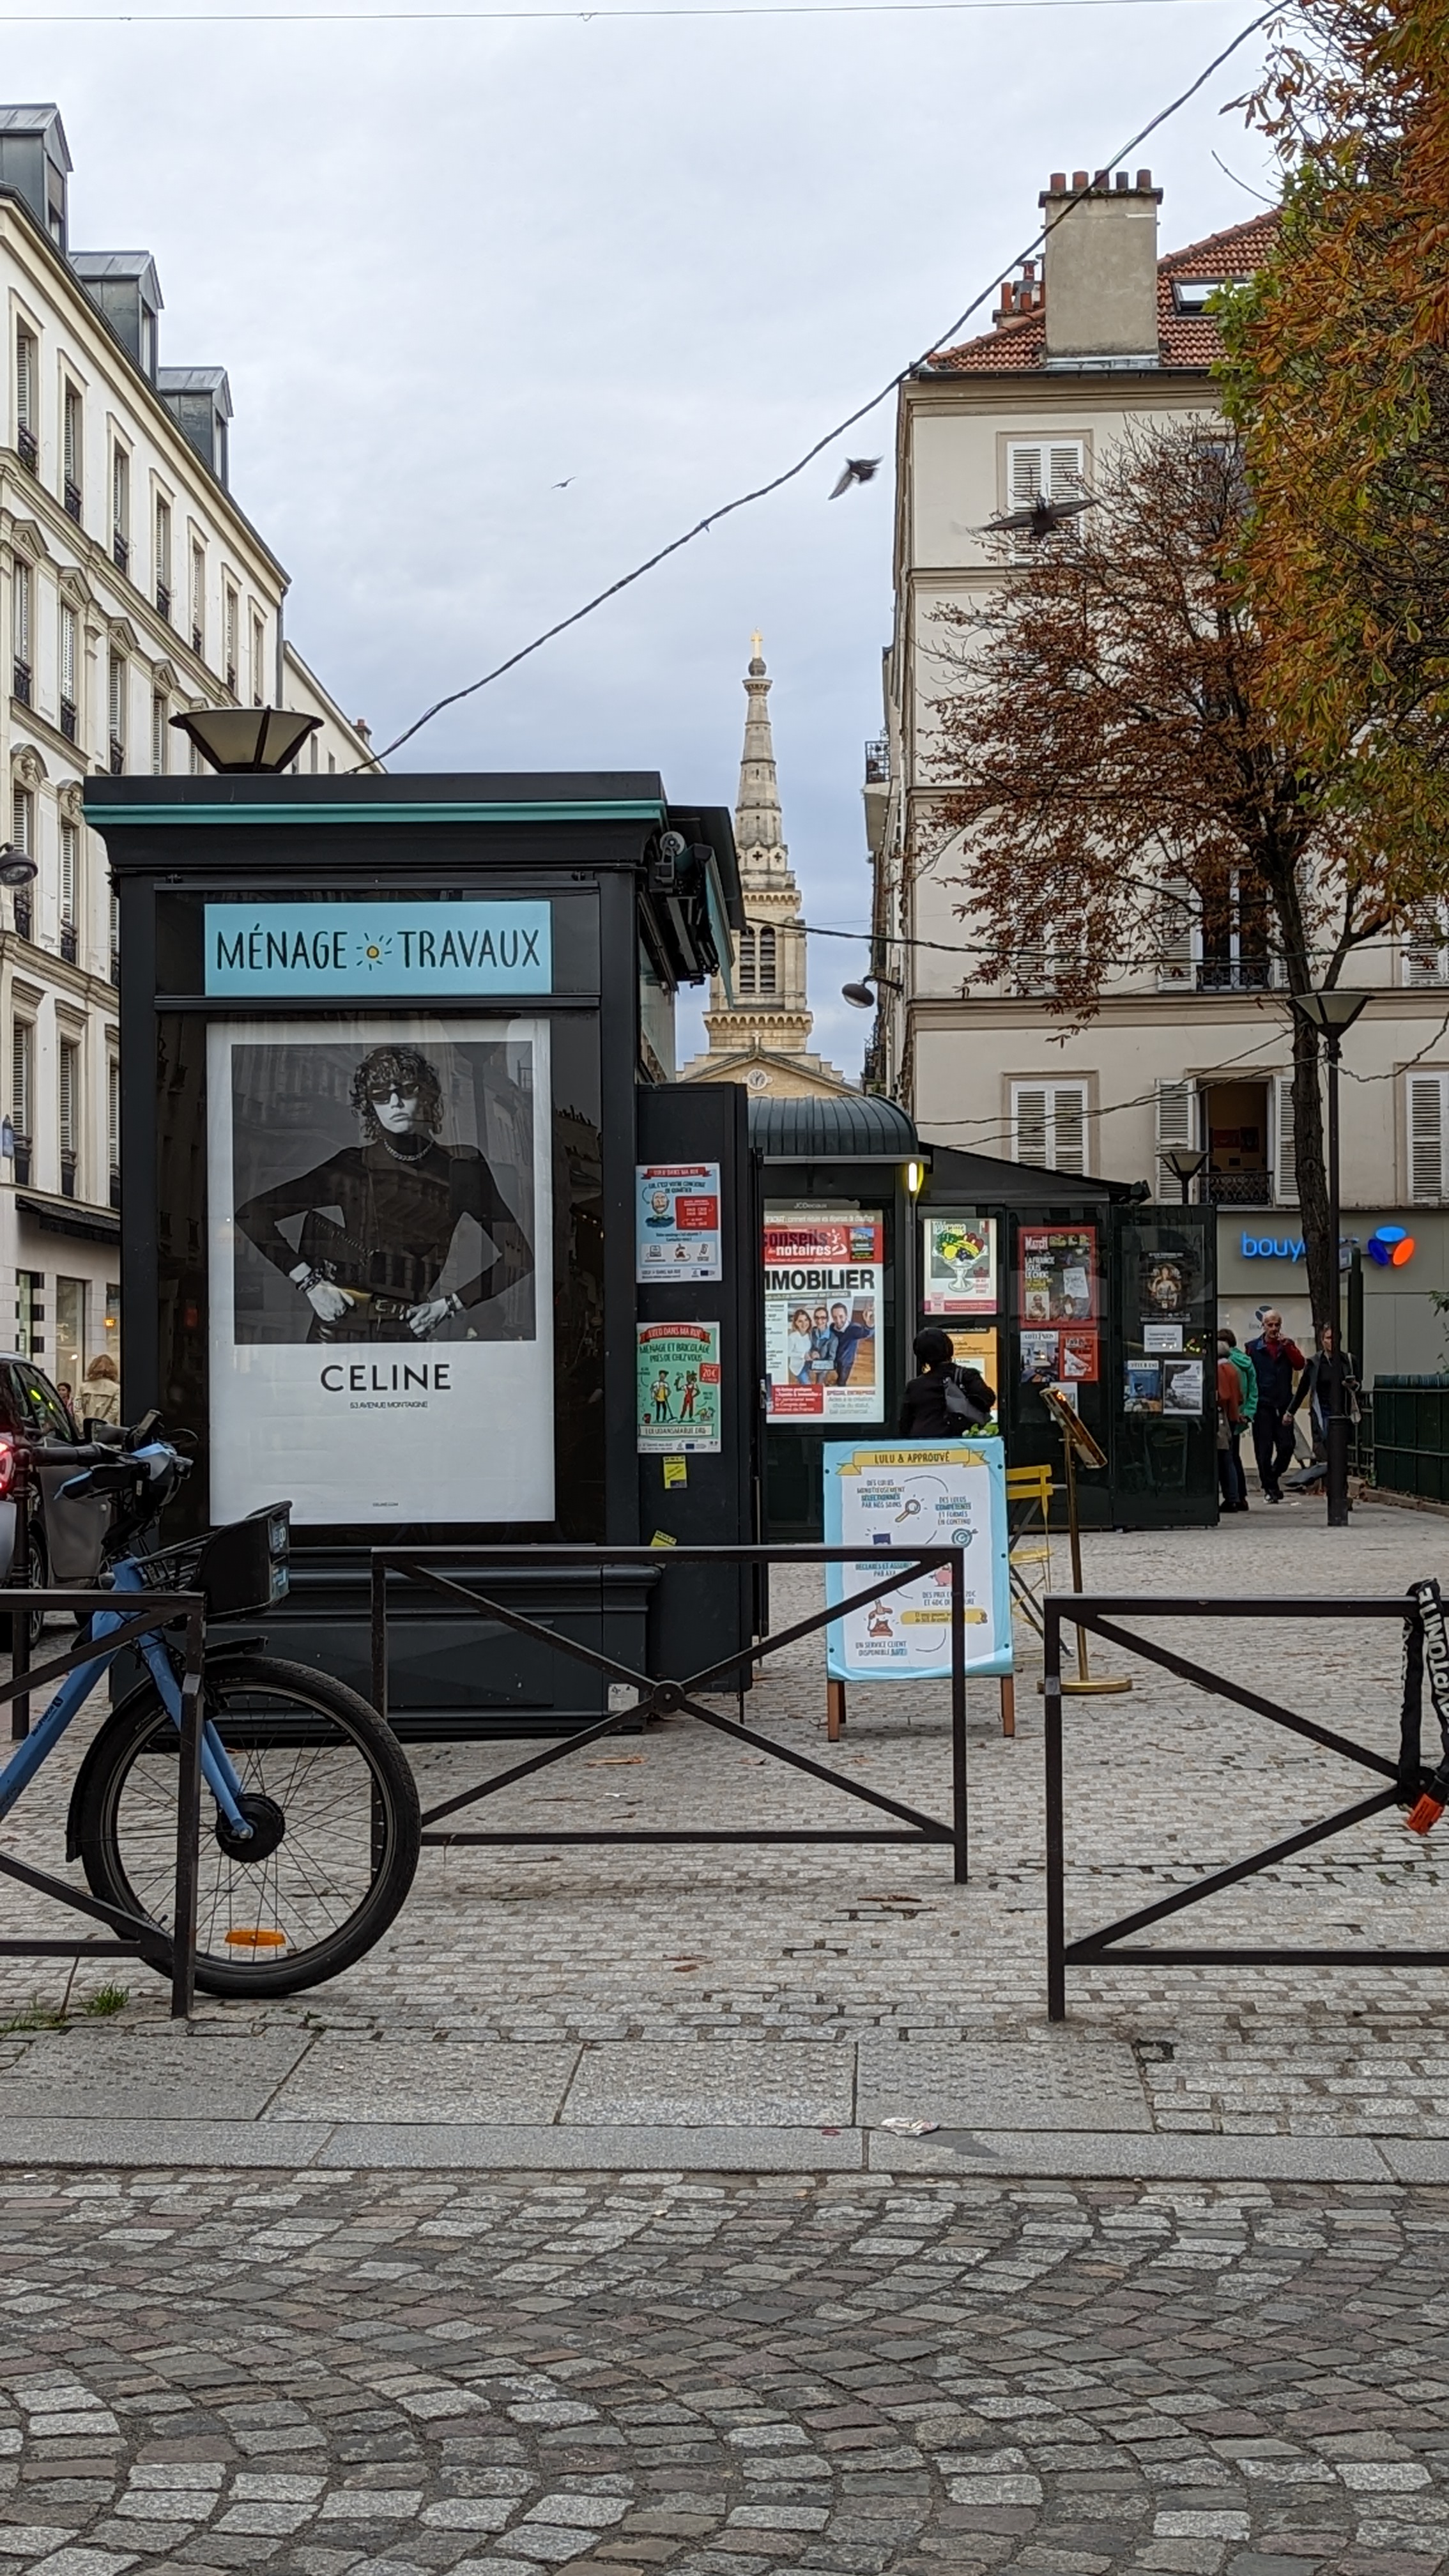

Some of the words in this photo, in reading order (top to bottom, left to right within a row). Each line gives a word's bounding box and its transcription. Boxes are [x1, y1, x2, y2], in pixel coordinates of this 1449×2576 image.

[217, 923, 348, 970] MÉNAGE
[397, 929, 541, 969] TRAVAUX
[764, 1229, 829, 1246] onseils
[1241, 1230, 1307, 1263] bouy
[776, 1244, 831, 1256] notaires
[1033, 1256, 1055, 1264] FRANCE
[321, 1364, 452, 1392] CELINE
[875, 1453, 895, 1464] LULU
[898, 1453, 904, 1463] &
[907, 1450, 950, 1462] APPROUVÉ
[1418, 1587, 1449, 1734] YPTONITE
